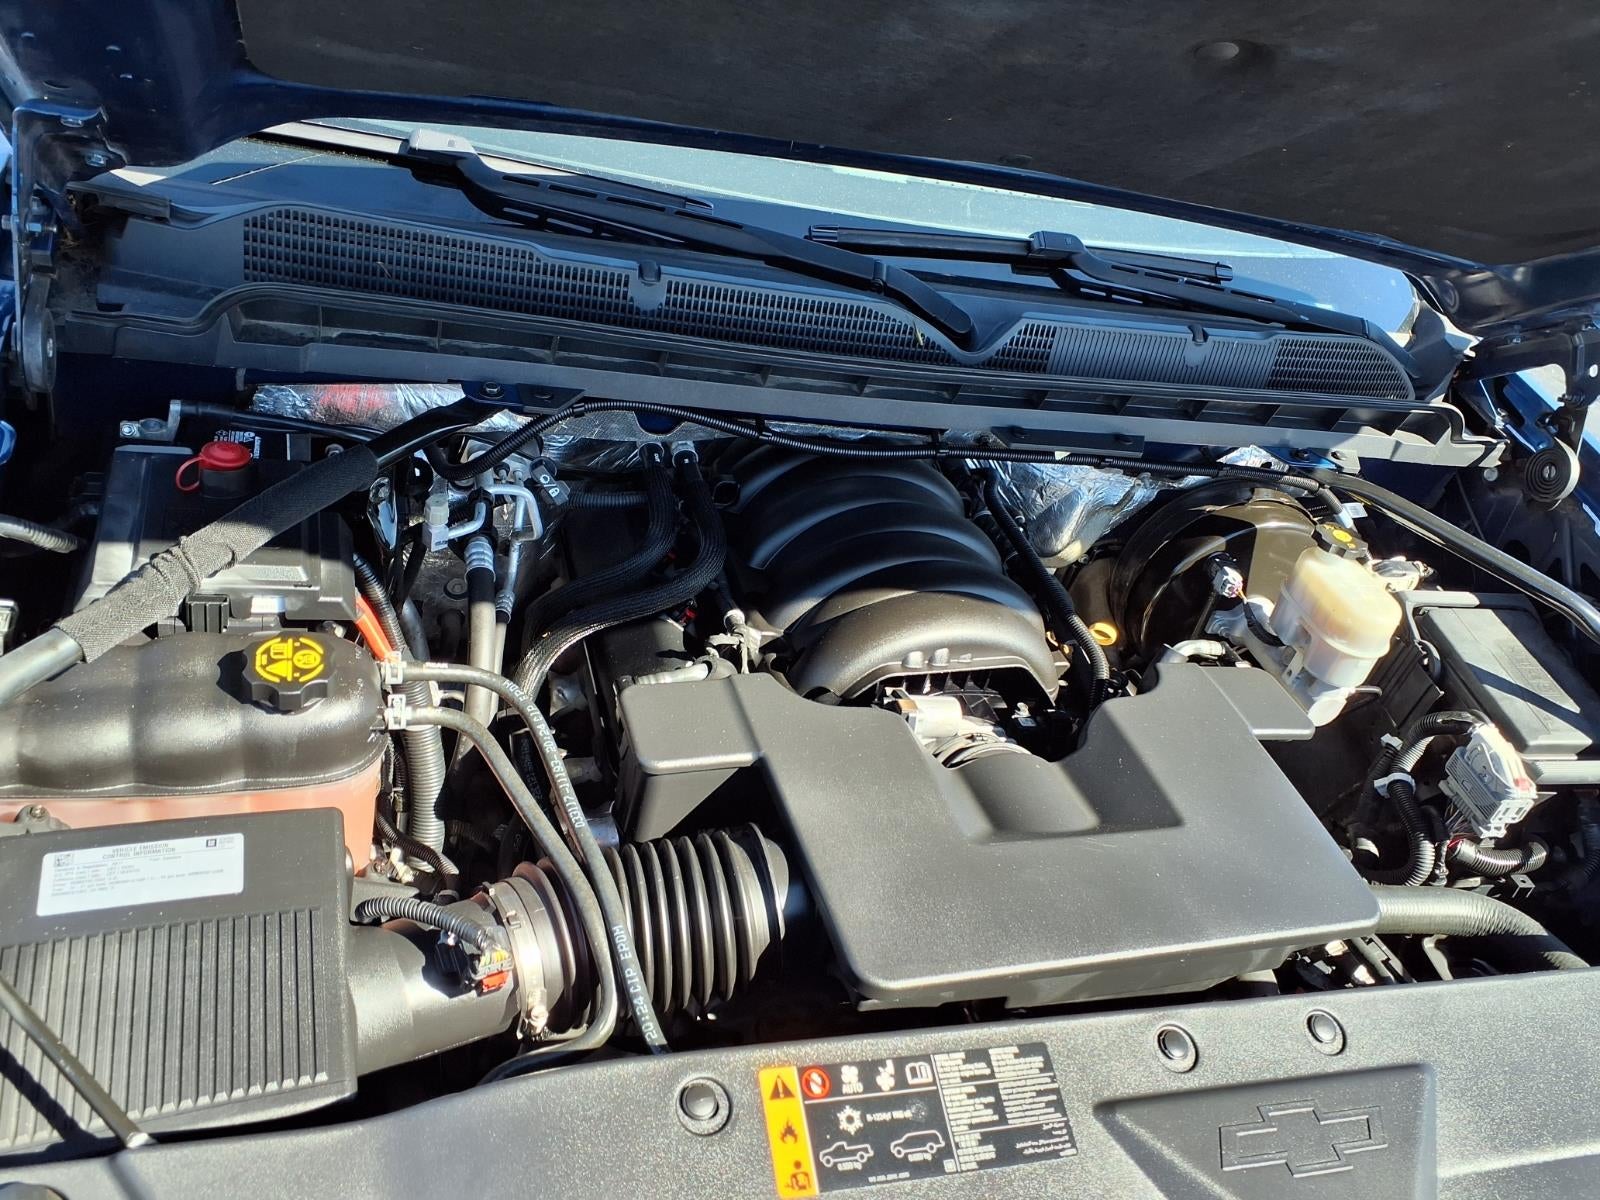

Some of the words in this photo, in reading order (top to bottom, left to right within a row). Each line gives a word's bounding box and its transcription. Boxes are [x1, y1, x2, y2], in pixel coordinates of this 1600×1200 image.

[503, 679, 529, 702] EPDM
[133, 847, 176, 857] INFORMATION
[613, 925, 632, 960] EPDM
[624, 967, 642, 993] CIP
[842, 1081, 864, 1094] AUTO
